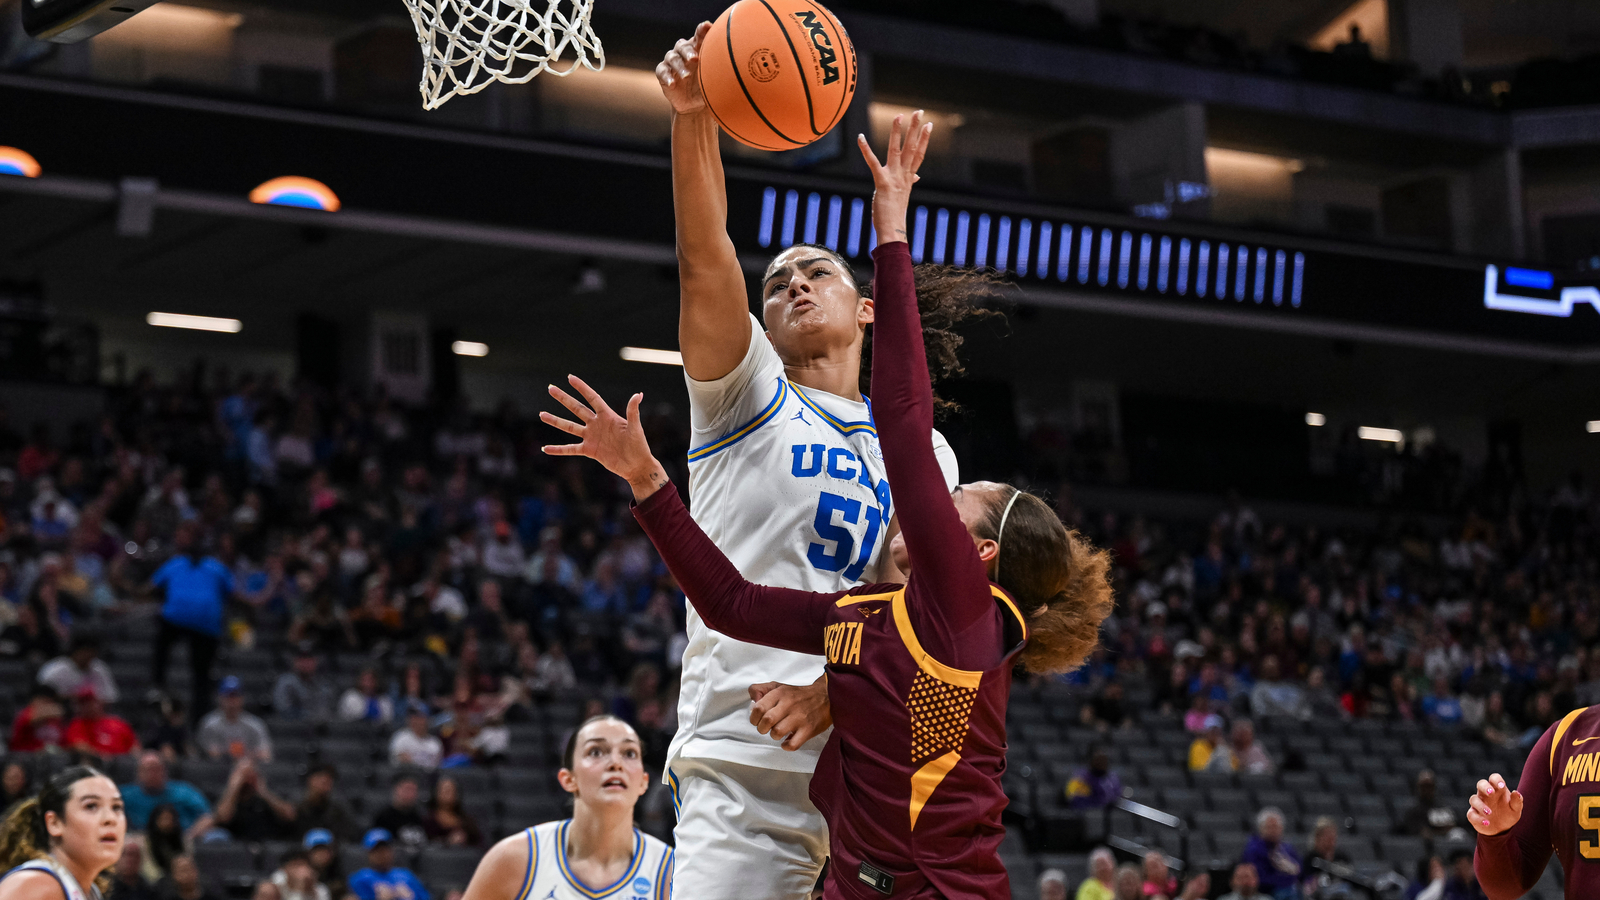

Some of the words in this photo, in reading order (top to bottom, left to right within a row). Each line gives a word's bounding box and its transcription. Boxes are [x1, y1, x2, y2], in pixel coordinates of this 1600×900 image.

[794, 10, 839, 86] NCAA
[807, 42, 818, 64] GAME
[814, 65, 822, 87] BALL
[791, 443, 891, 527] UCLA
[807, 491, 882, 582] 51
